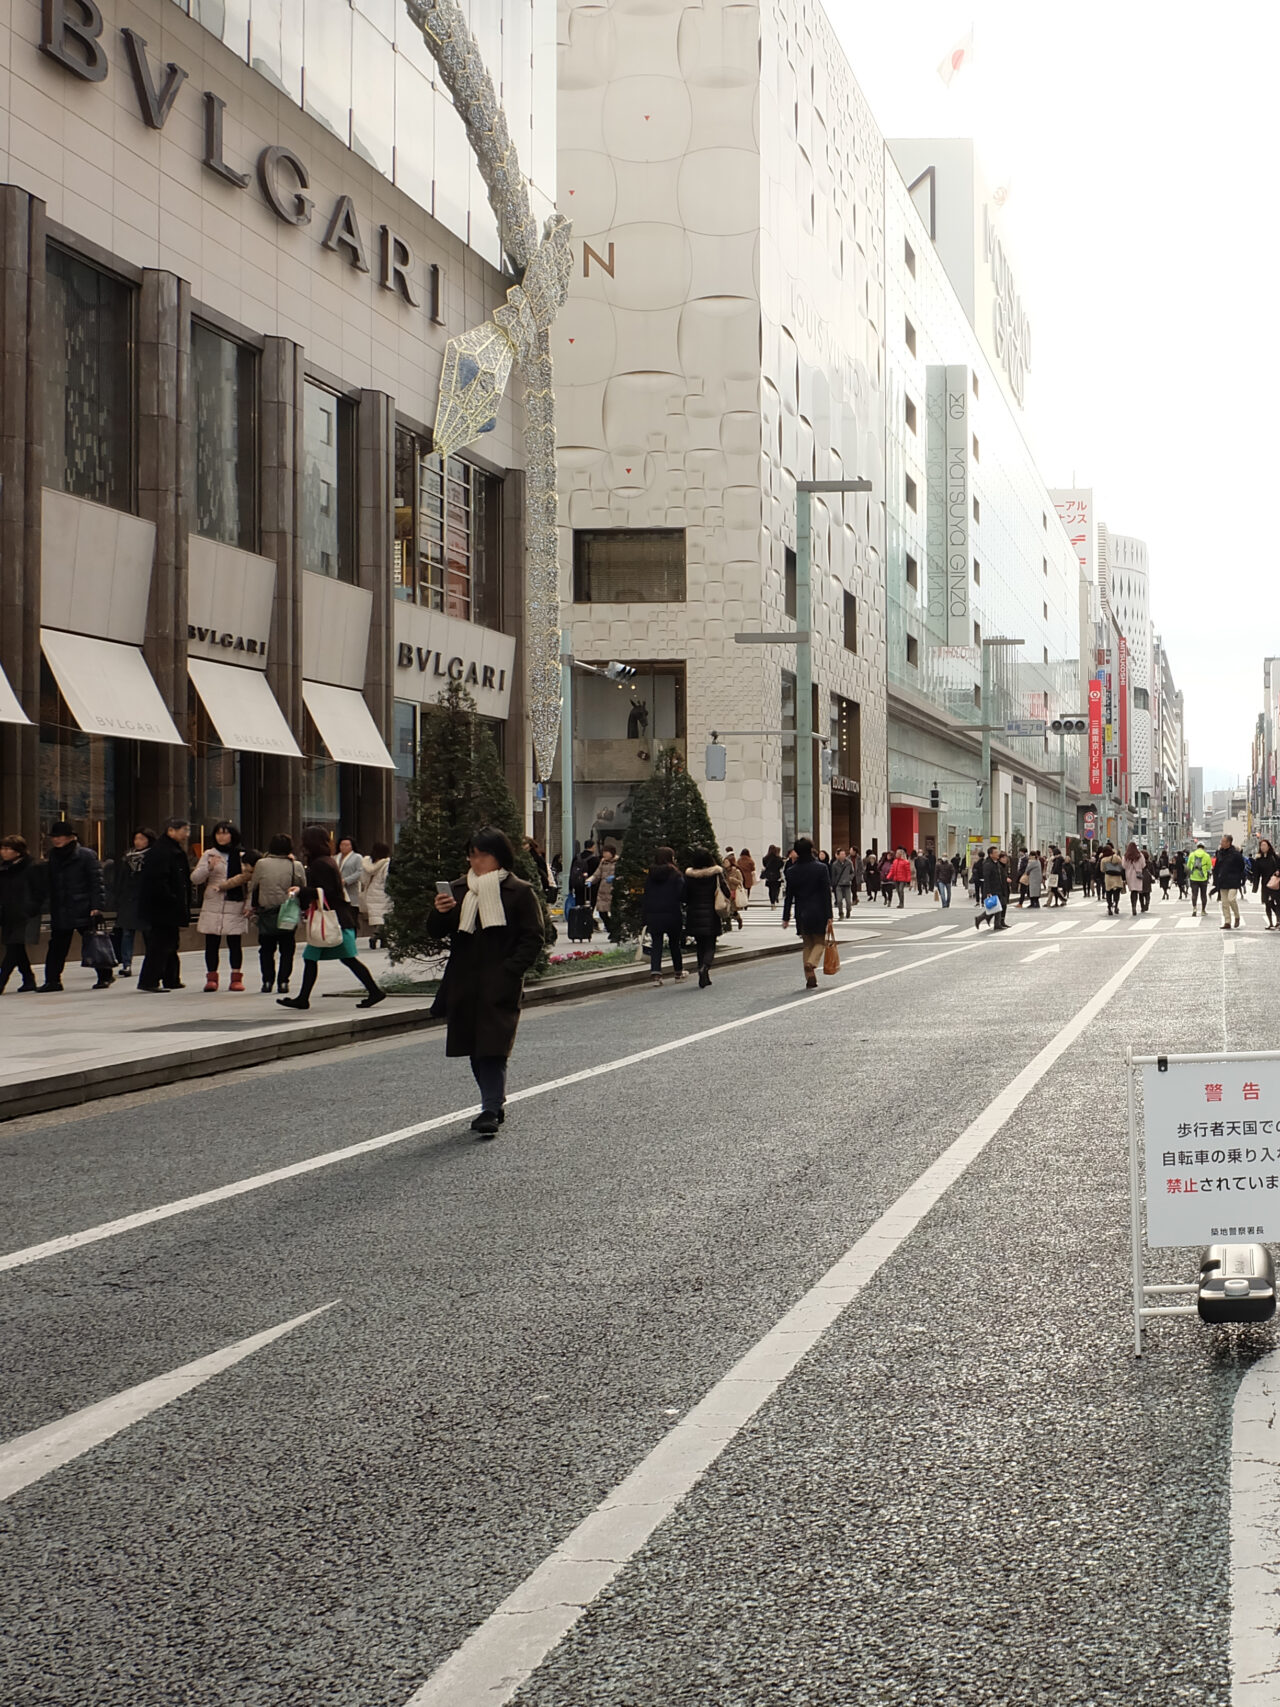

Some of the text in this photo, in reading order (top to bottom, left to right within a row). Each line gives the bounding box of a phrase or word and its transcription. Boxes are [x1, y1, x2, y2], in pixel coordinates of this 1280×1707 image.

[39, 0, 447, 327] BVLGARI
[569, 241, 614, 279] N
[188, 625, 266, 656] BVLGARI
[398, 642, 506, 691] BVLGARI
[96, 716, 161, 734] BVLGARI
[1204, 1081, 1261, 1102] 警告
[1210, 1225, 1265, 1237] 築地警察署長
